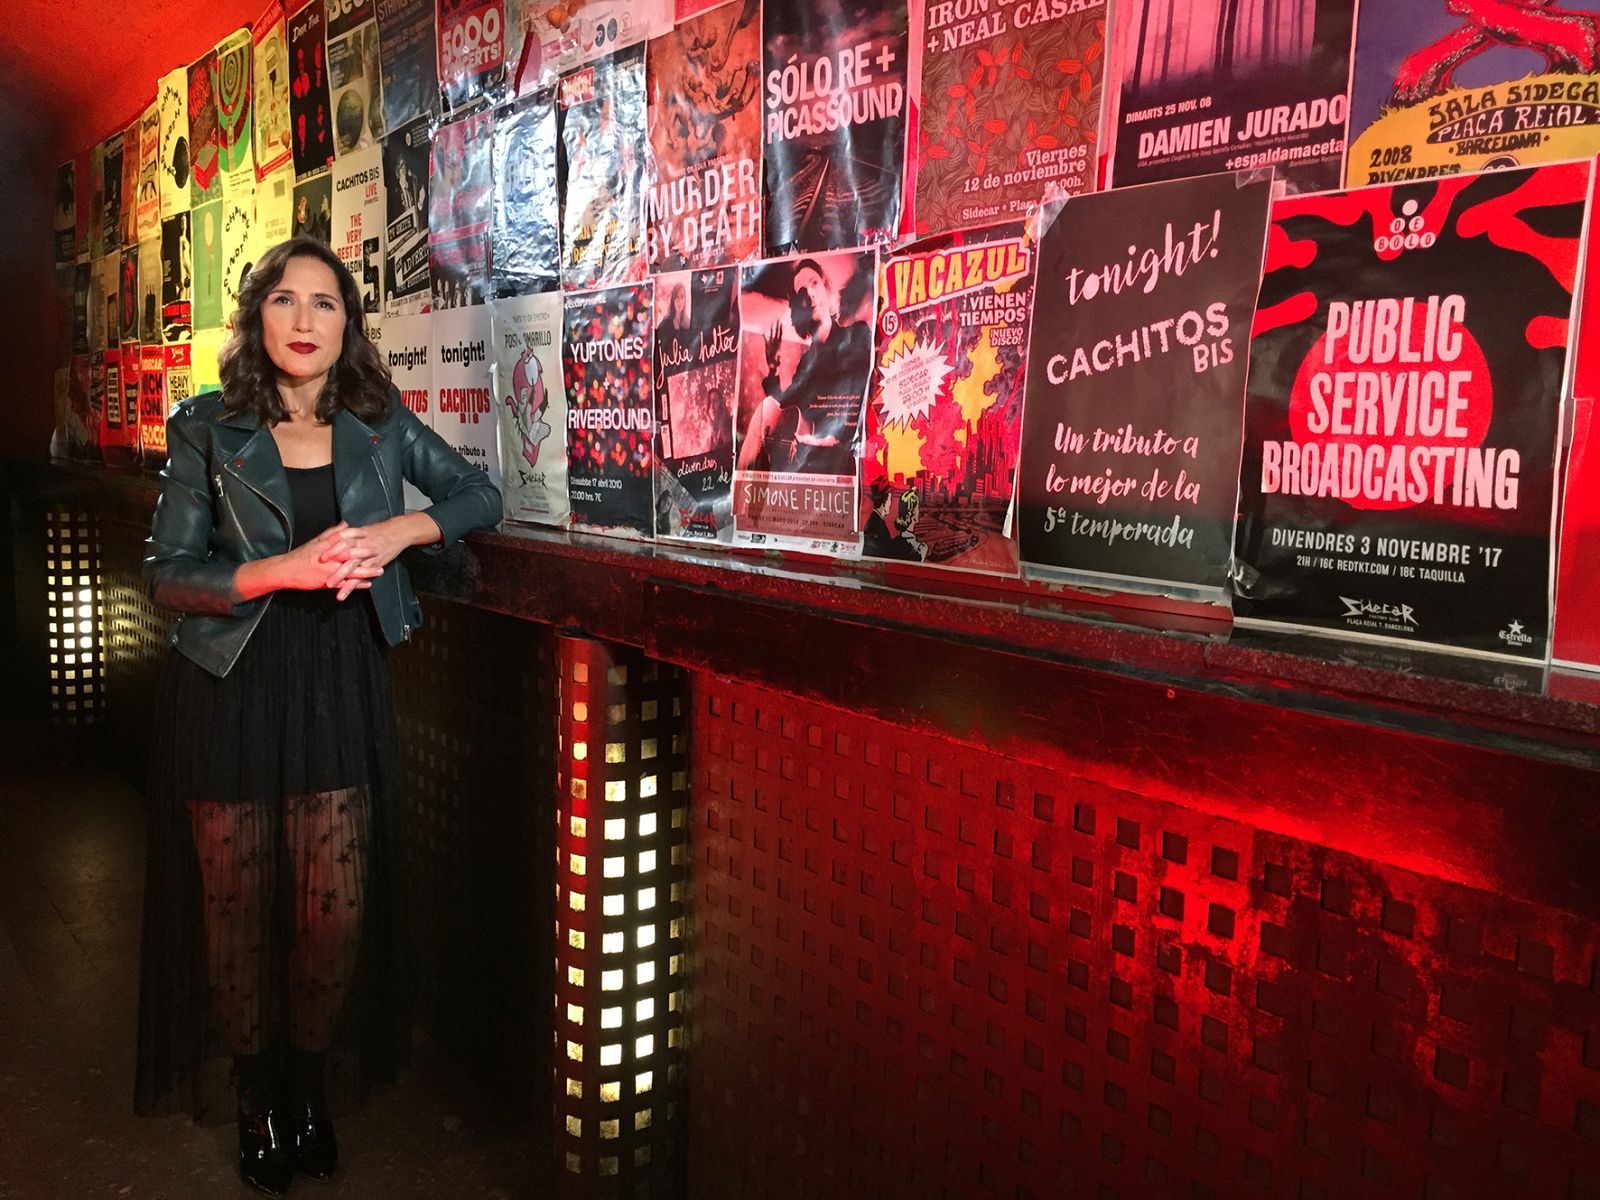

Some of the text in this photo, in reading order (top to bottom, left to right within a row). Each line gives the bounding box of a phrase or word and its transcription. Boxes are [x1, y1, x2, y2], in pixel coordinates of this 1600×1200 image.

[442, 8, 500, 64] 5000
[766, 54, 832, 110] SÓLO
[837, 42, 872, 93] RE
[766, 82, 903, 144] PICASSOUND
[1125, 96, 1212, 124] DIMARTS 25 NOV. 08
[1428, 90, 1497, 131] SALA
[1138, 94, 1348, 160] DAMIEN JURADO
[1026, 144, 1087, 168] Viernes
[1370, 144, 1413, 168] 2008
[336, 170, 368, 193] CACHITOS
[369, 166, 380, 181] BIS
[365, 182, 377, 198] LIVE
[649, 158, 756, 223] MURDER
[963, 158, 1086, 194] 12 de noviembre
[350, 212, 362, 228] THE
[683, 199, 761, 252] DEATH
[962, 201, 999, 221] Sidecar
[346, 228, 362, 244] VERY
[354, 243, 362, 258] OF
[1065, 209, 1221, 306] tonight!
[895, 245, 1026, 309] VACAZUL
[959, 307, 1026, 326] TIEMPOS
[1324, 294, 1465, 364] PUBLIC
[441, 340, 485, 367] tonight!
[570, 337, 644, 364] YUPTONES
[657, 325, 738, 390] julia holter
[1046, 302, 1229, 385] CACHITOS
[1193, 338, 1234, 373] BIS
[388, 346, 427, 371] tonight!
[169, 375, 189, 389] HEAVY
[439, 387, 490, 414] CACHITOS
[1307, 370, 1472, 437] SERVICE
[568, 408, 651, 431] RIVERBOUND
[481, 448, 486, 458] a
[1054, 422, 1199, 459] Un tributo a
[482, 461, 489, 473] la
[702, 464, 731, 492] 22 de
[1260, 440, 1520, 509] BROADCASTING
[744, 483, 799, 510] SIMONE
[805, 489, 850, 514] FELICE
[1045, 463, 1201, 505] lo mejor de la
[1071, 511, 1195, 550] temporada
[1272, 528, 1355, 554] DIVENDRES
[1361, 536, 1370, 555] 3
[1377, 537, 1471, 565] NOVEMBRE
[1296, 555, 1311, 567] 21H
[1319, 557, 1334, 569] 16€
[1337, 559, 1389, 576] REDTKT.COM
[1400, 566, 1415, 578] 18€
[1419, 568, 1465, 583] TAQUILLA
[1498, 629, 1533, 644] Estrella
